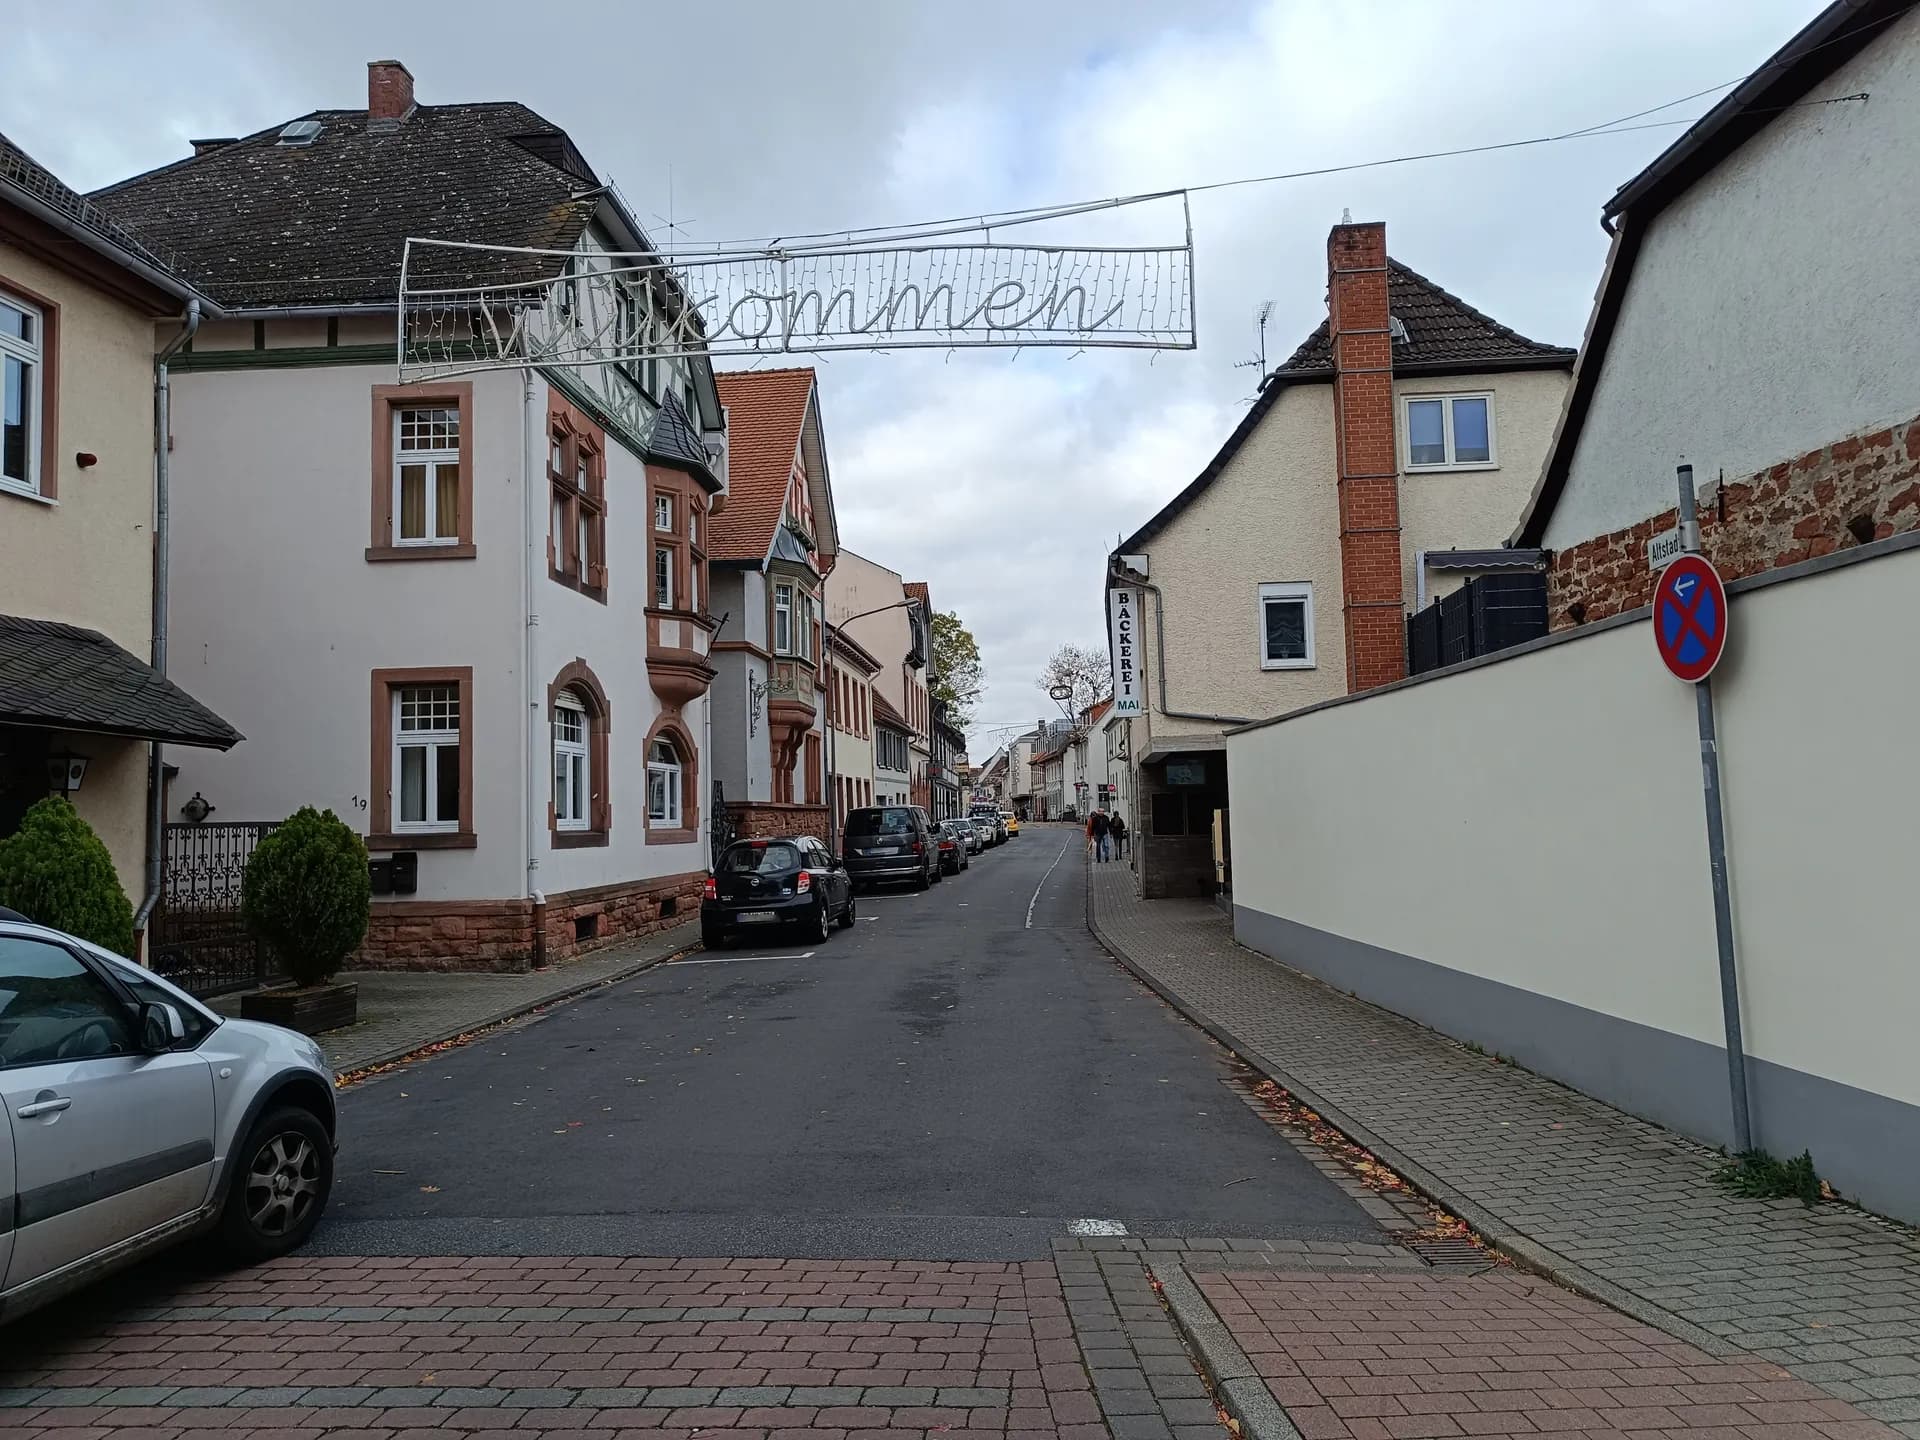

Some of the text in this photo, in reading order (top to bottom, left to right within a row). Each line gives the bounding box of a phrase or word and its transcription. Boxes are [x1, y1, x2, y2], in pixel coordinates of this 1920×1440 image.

[1652, 533, 1681, 562] Altstad
[1118, 592, 1133, 695] BÄCKEREI
[1117, 700, 1139, 710] MAI
[351, 795, 367, 811] 19
